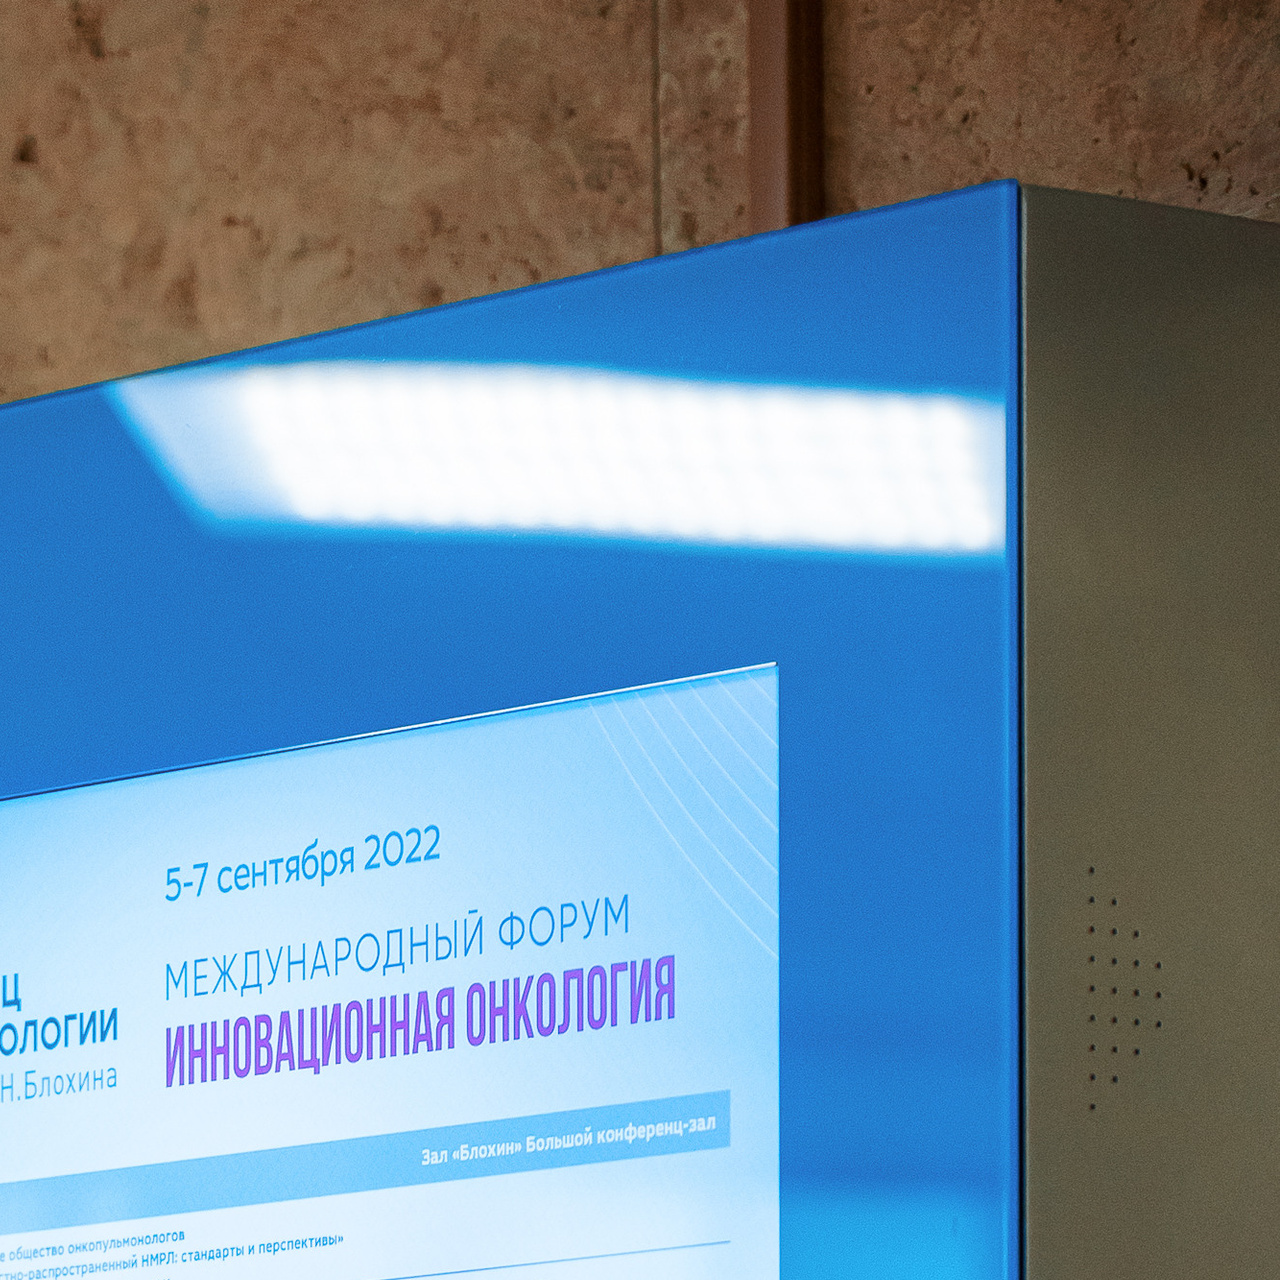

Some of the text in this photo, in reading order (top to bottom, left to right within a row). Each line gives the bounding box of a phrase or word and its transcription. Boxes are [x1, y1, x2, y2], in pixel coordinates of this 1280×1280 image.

[165, 824, 441, 901] 5-7 сентября 2022
[165, 894, 629, 1001] МЕЖДУНАРОДНЫЙ ФОРУМ
[165, 954, 675, 1088] ИННОВАЦИОННАЯ ОНКОЛОГИЯ
[421, 1115, 716, 1166] Зал «Блохин» Большой конференц-зал
[8, 1245, 65, 1261] общество
[67, 1231, 185, 1254] онкопульмонологов
[141, 1250, 178, 1267] НМРЛ:
[180, 1246, 245, 1263] стандарты
